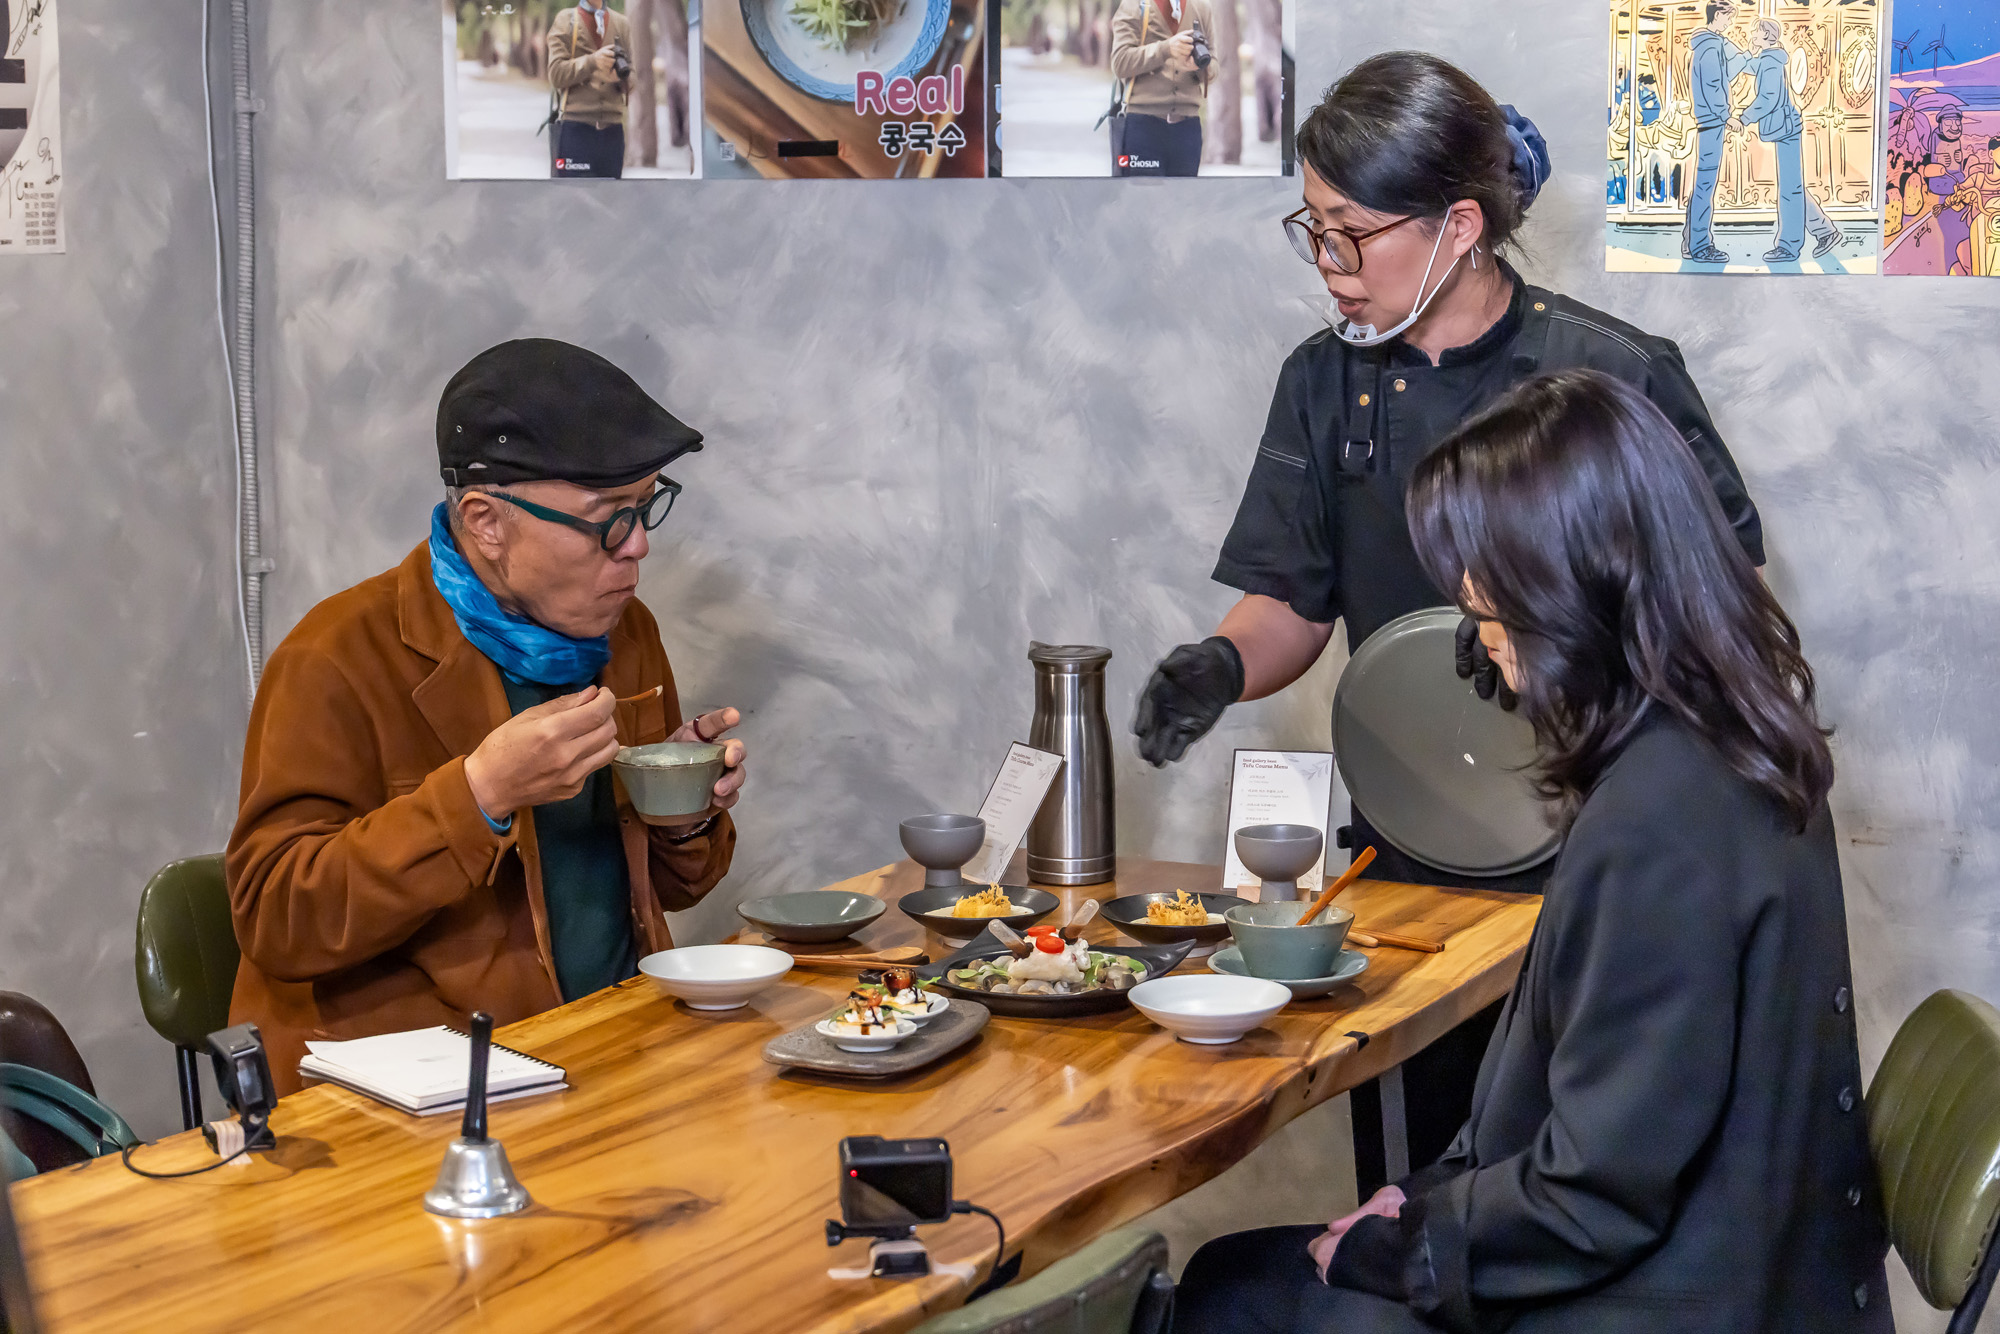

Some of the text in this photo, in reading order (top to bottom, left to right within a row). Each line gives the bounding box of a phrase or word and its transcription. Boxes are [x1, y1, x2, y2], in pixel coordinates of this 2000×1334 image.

[855, 64, 964, 116] Real
[878, 121, 967, 158] 콩국수
[1129, 160, 1160, 168] CHOSUN
